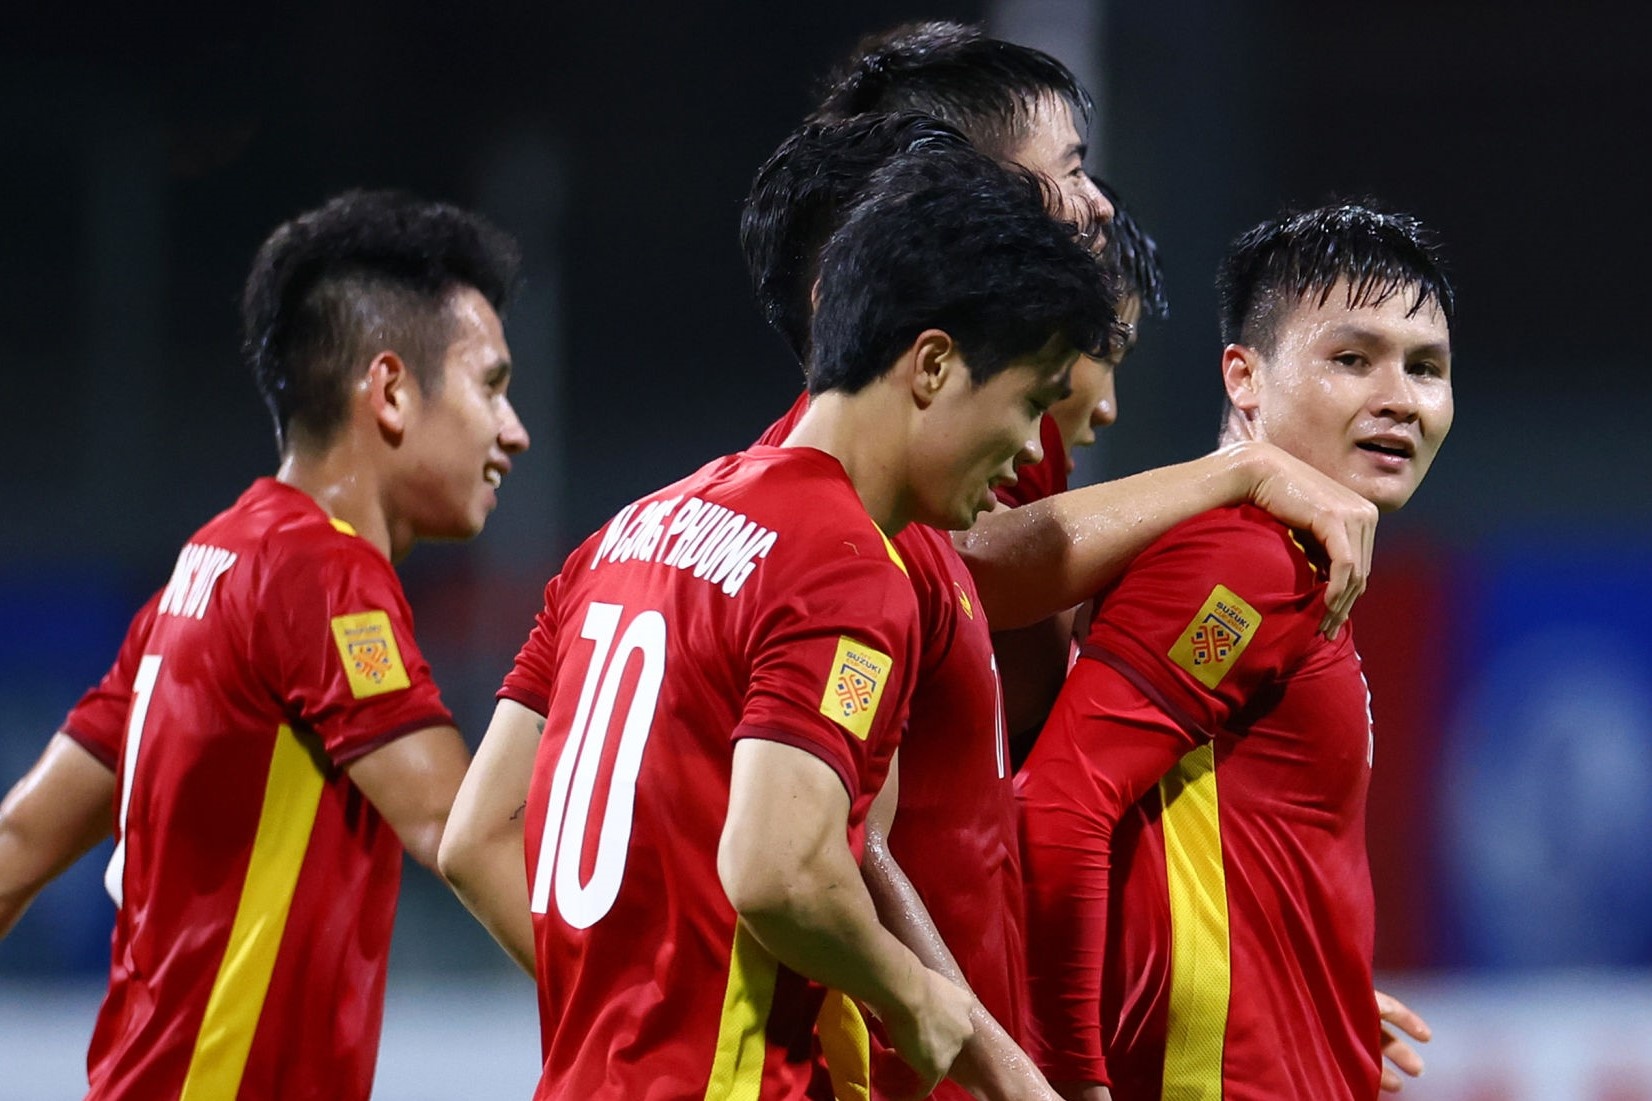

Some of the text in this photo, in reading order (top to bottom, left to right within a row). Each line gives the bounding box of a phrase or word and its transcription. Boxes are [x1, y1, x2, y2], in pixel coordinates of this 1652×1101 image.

[655, 496, 778, 598] PHUONG
[1216, 601, 1250, 629] SUZUKI
[846, 651, 882, 674] SUZUKI
[530, 601, 667, 930] 10
